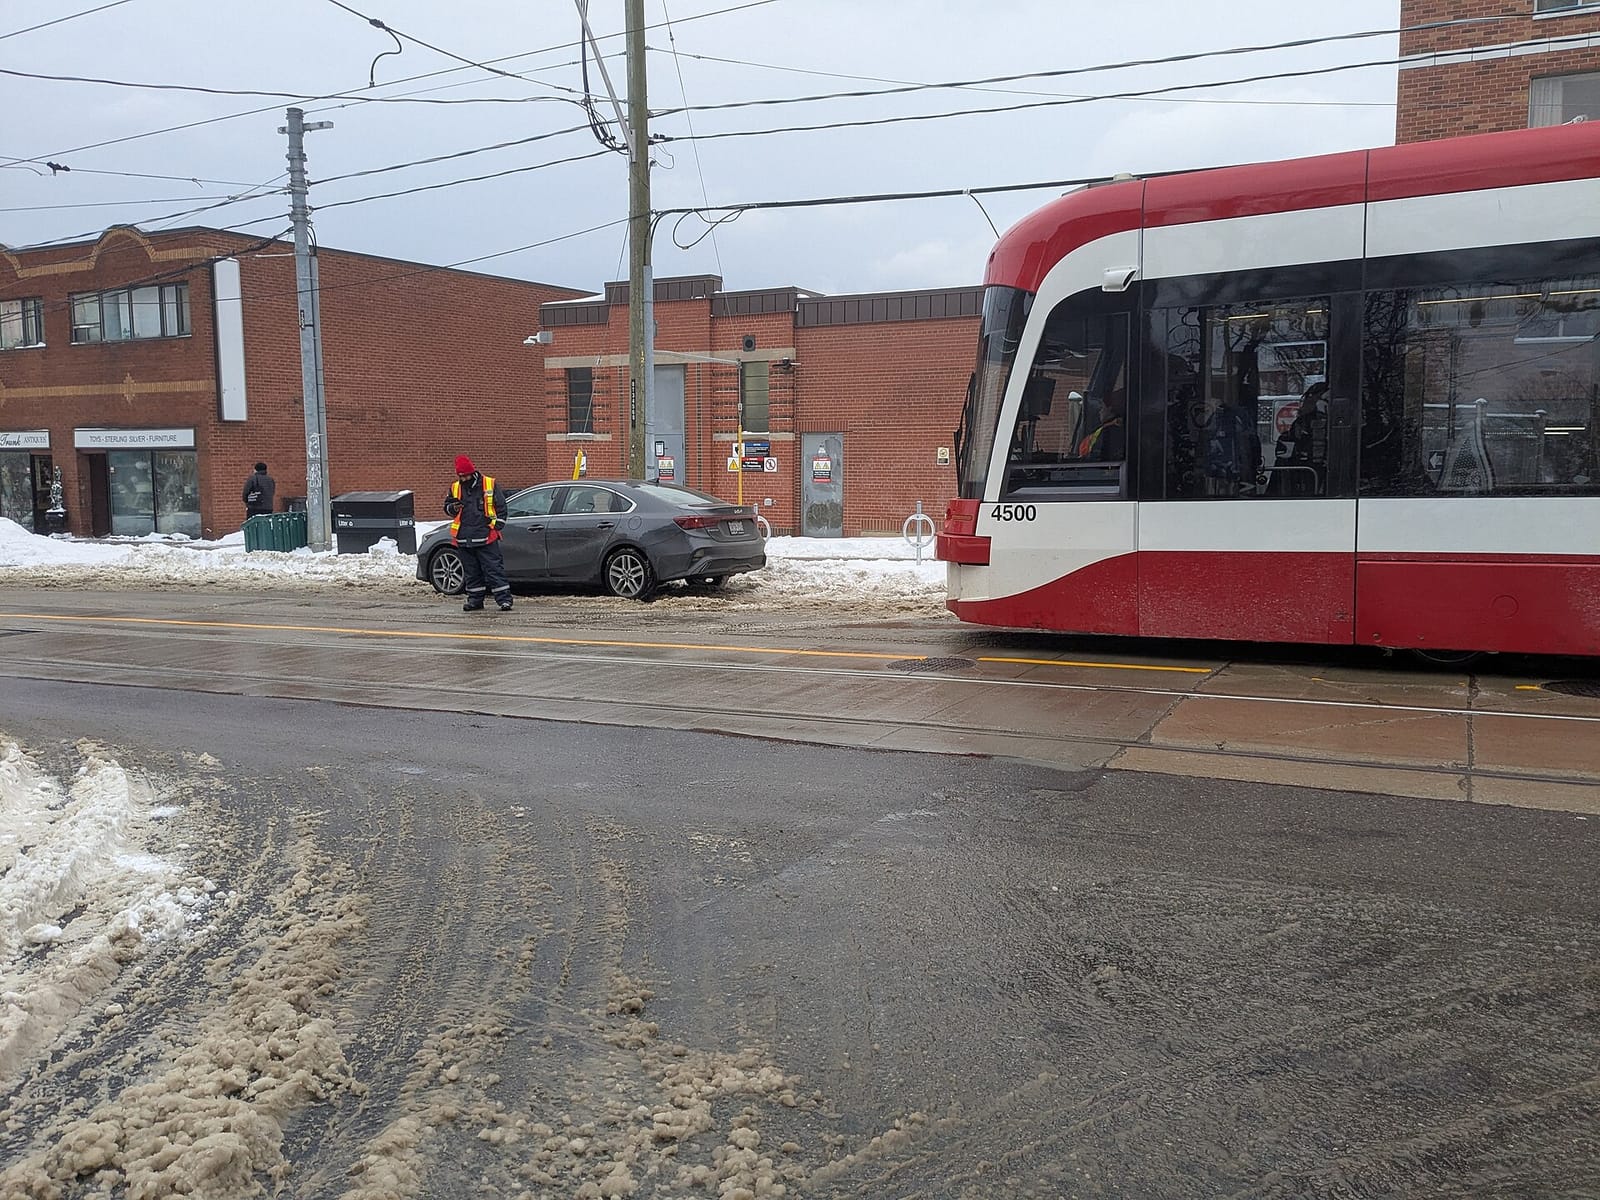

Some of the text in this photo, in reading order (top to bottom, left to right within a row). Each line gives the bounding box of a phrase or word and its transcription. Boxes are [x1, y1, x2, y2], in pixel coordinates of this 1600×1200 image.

[89, 434, 177, 443] TOYS STERLING SILVER FURNITURE
[991, 505, 1037, 521] 4500
